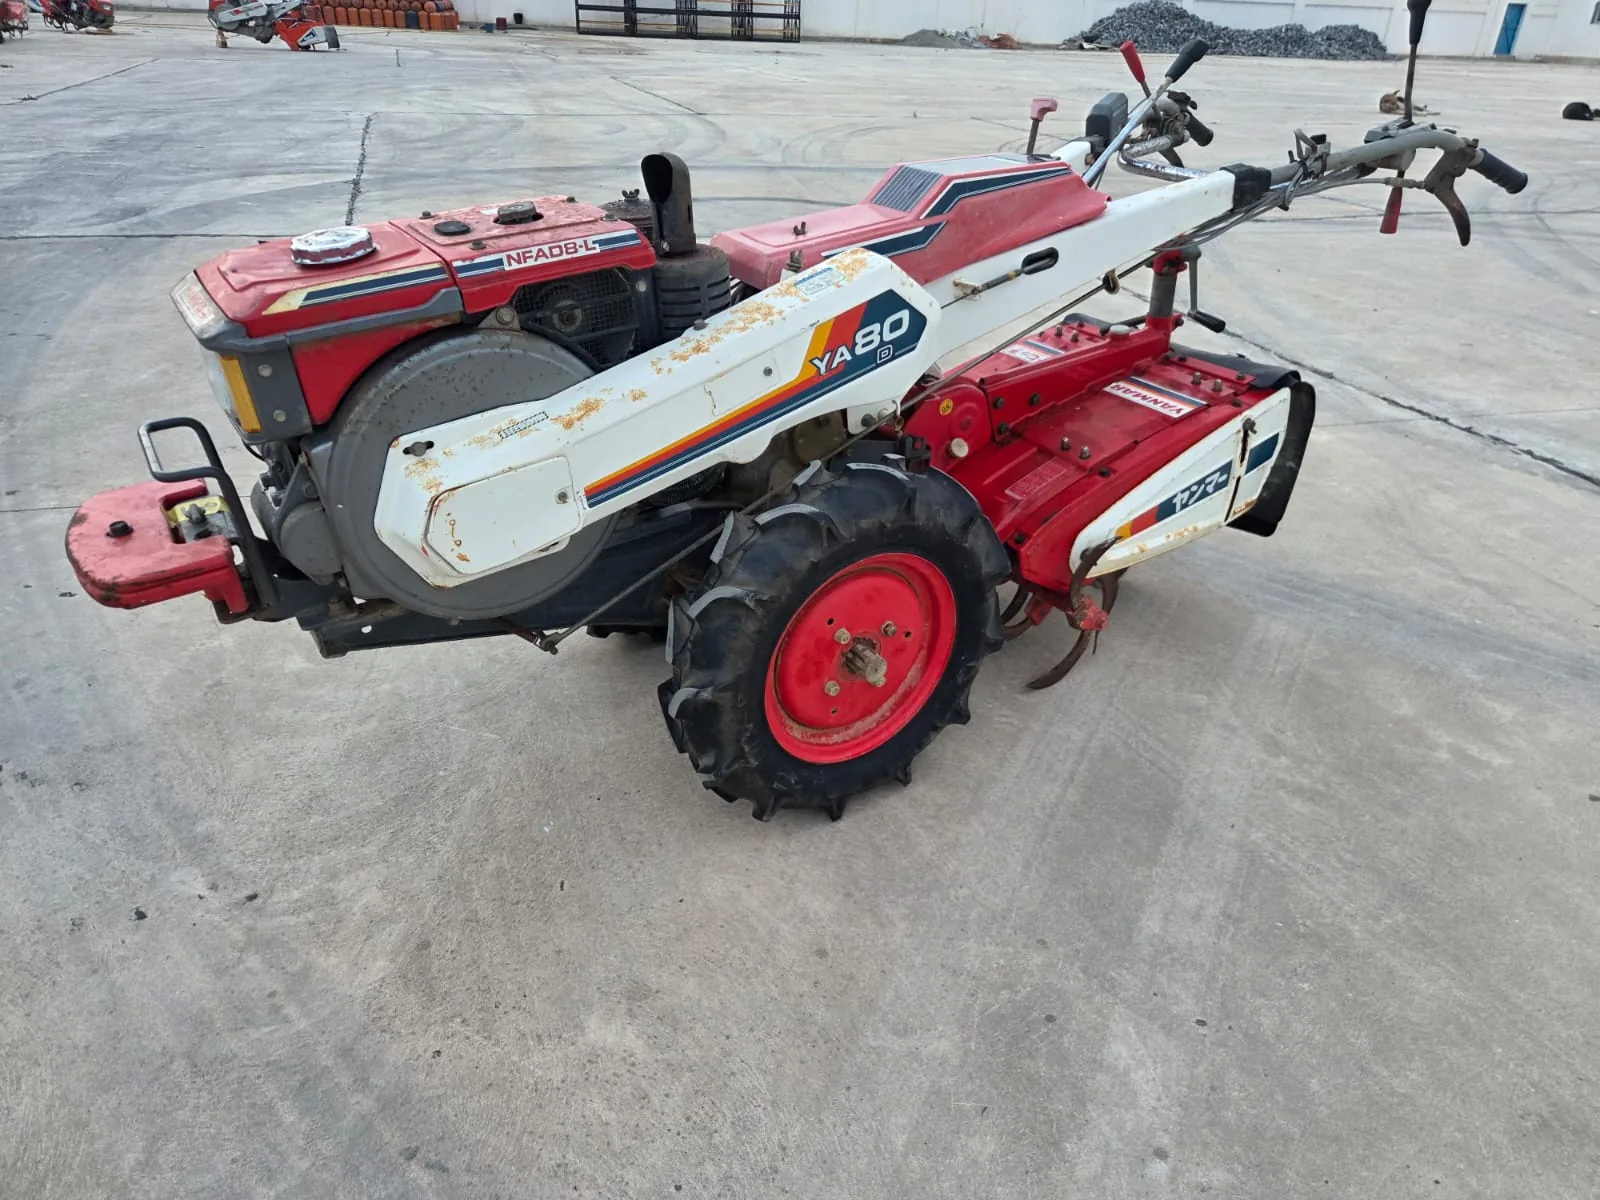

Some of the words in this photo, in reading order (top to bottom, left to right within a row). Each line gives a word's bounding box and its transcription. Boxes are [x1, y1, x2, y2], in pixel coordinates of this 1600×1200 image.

[506, 239, 597, 267] NFAD8-L
[1109, 384, 1184, 414] YANMAR
[1172, 471, 1228, 513] ヤンマー
